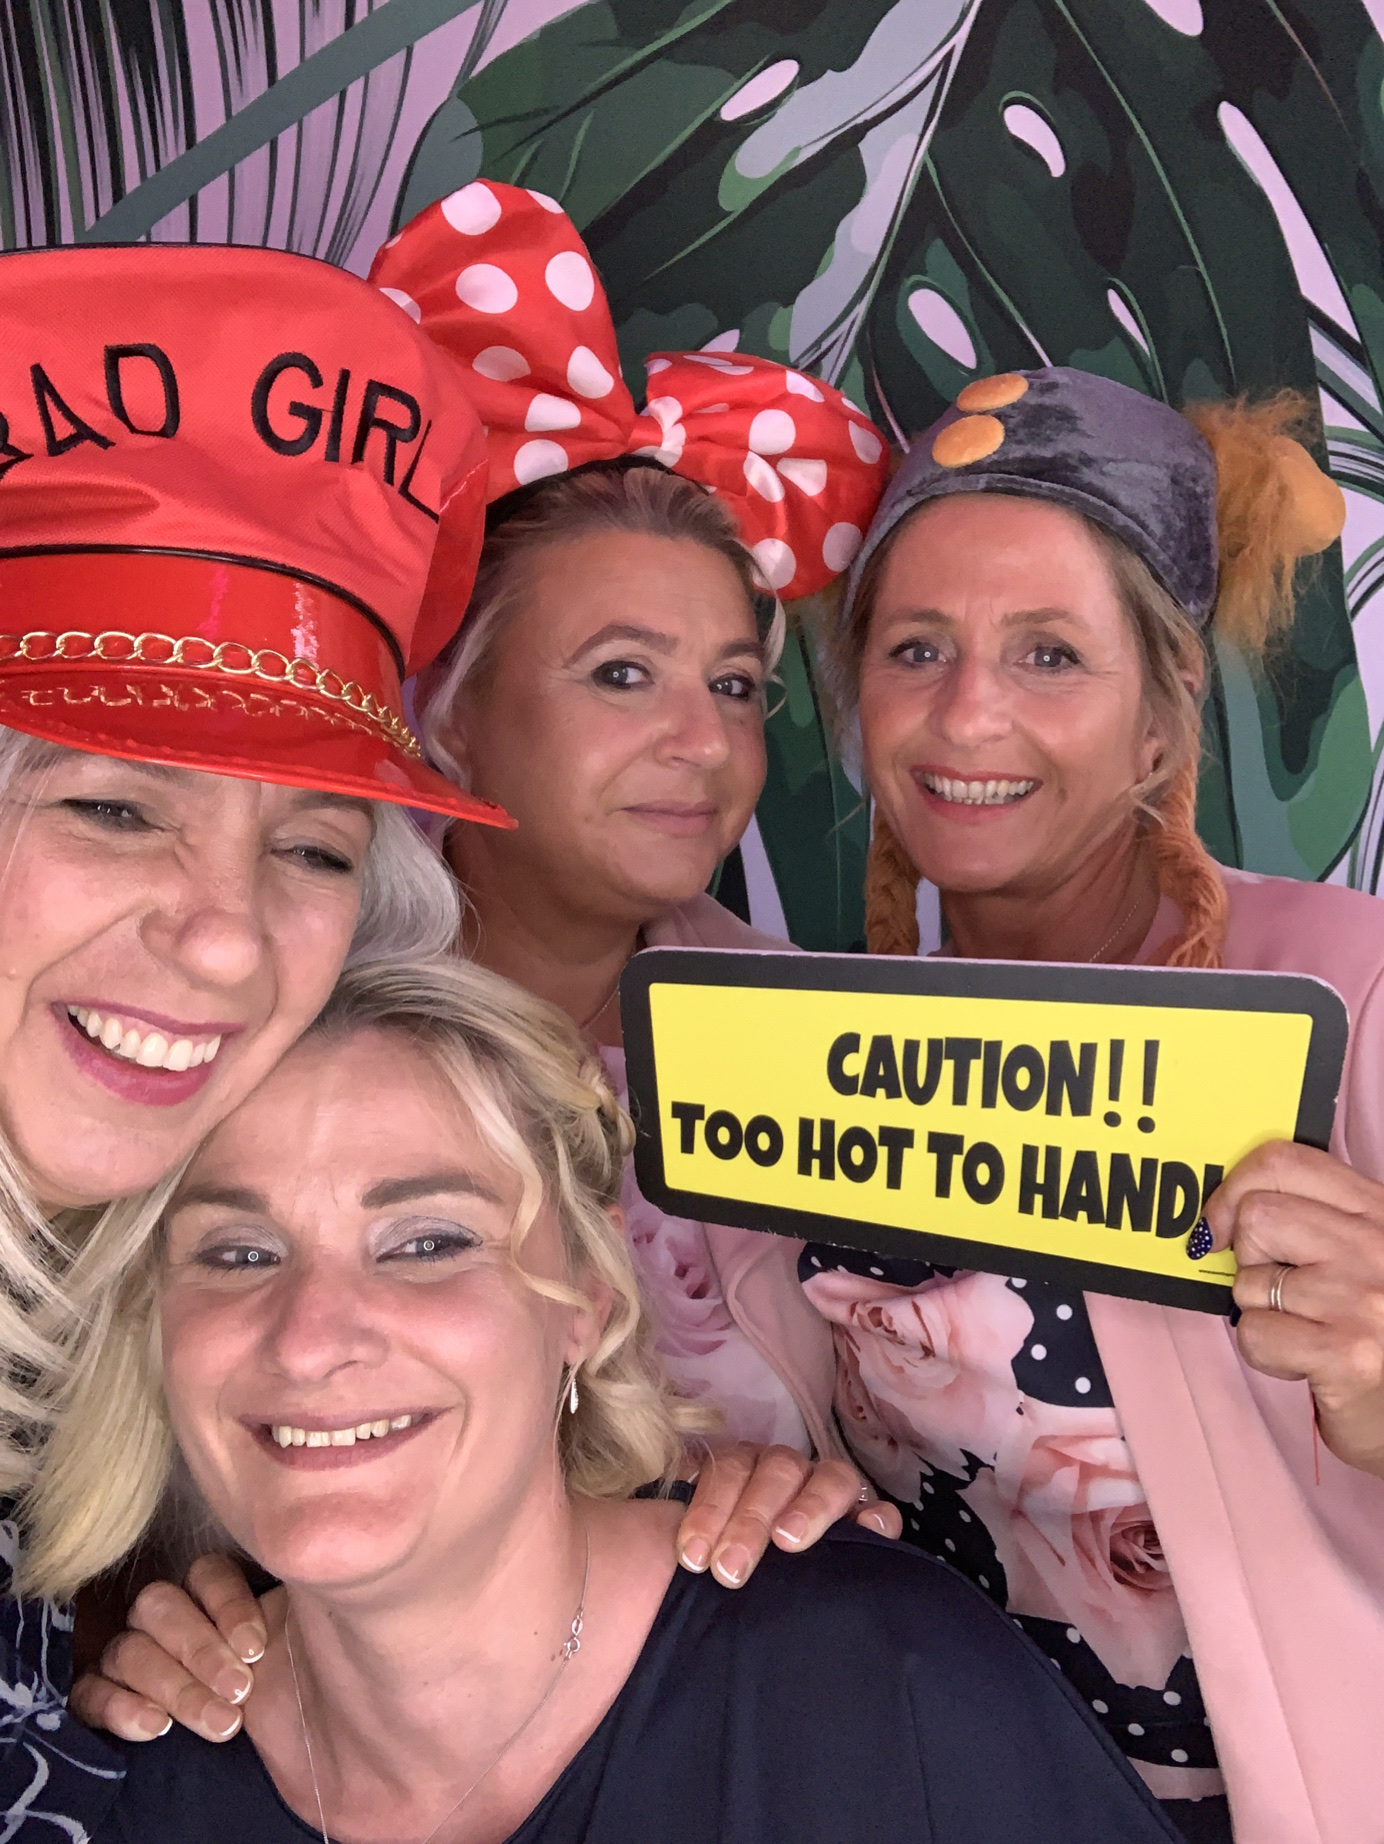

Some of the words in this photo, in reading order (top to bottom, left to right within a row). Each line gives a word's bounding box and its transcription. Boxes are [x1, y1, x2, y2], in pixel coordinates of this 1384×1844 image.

[250, 351, 440, 525] GIRL
[826, 1031, 1161, 1134] CAUTION!!
[670, 1101, 784, 1168] TOO
[798, 1116, 915, 1190] HOT
[927, 1131, 1006, 1205] TO
